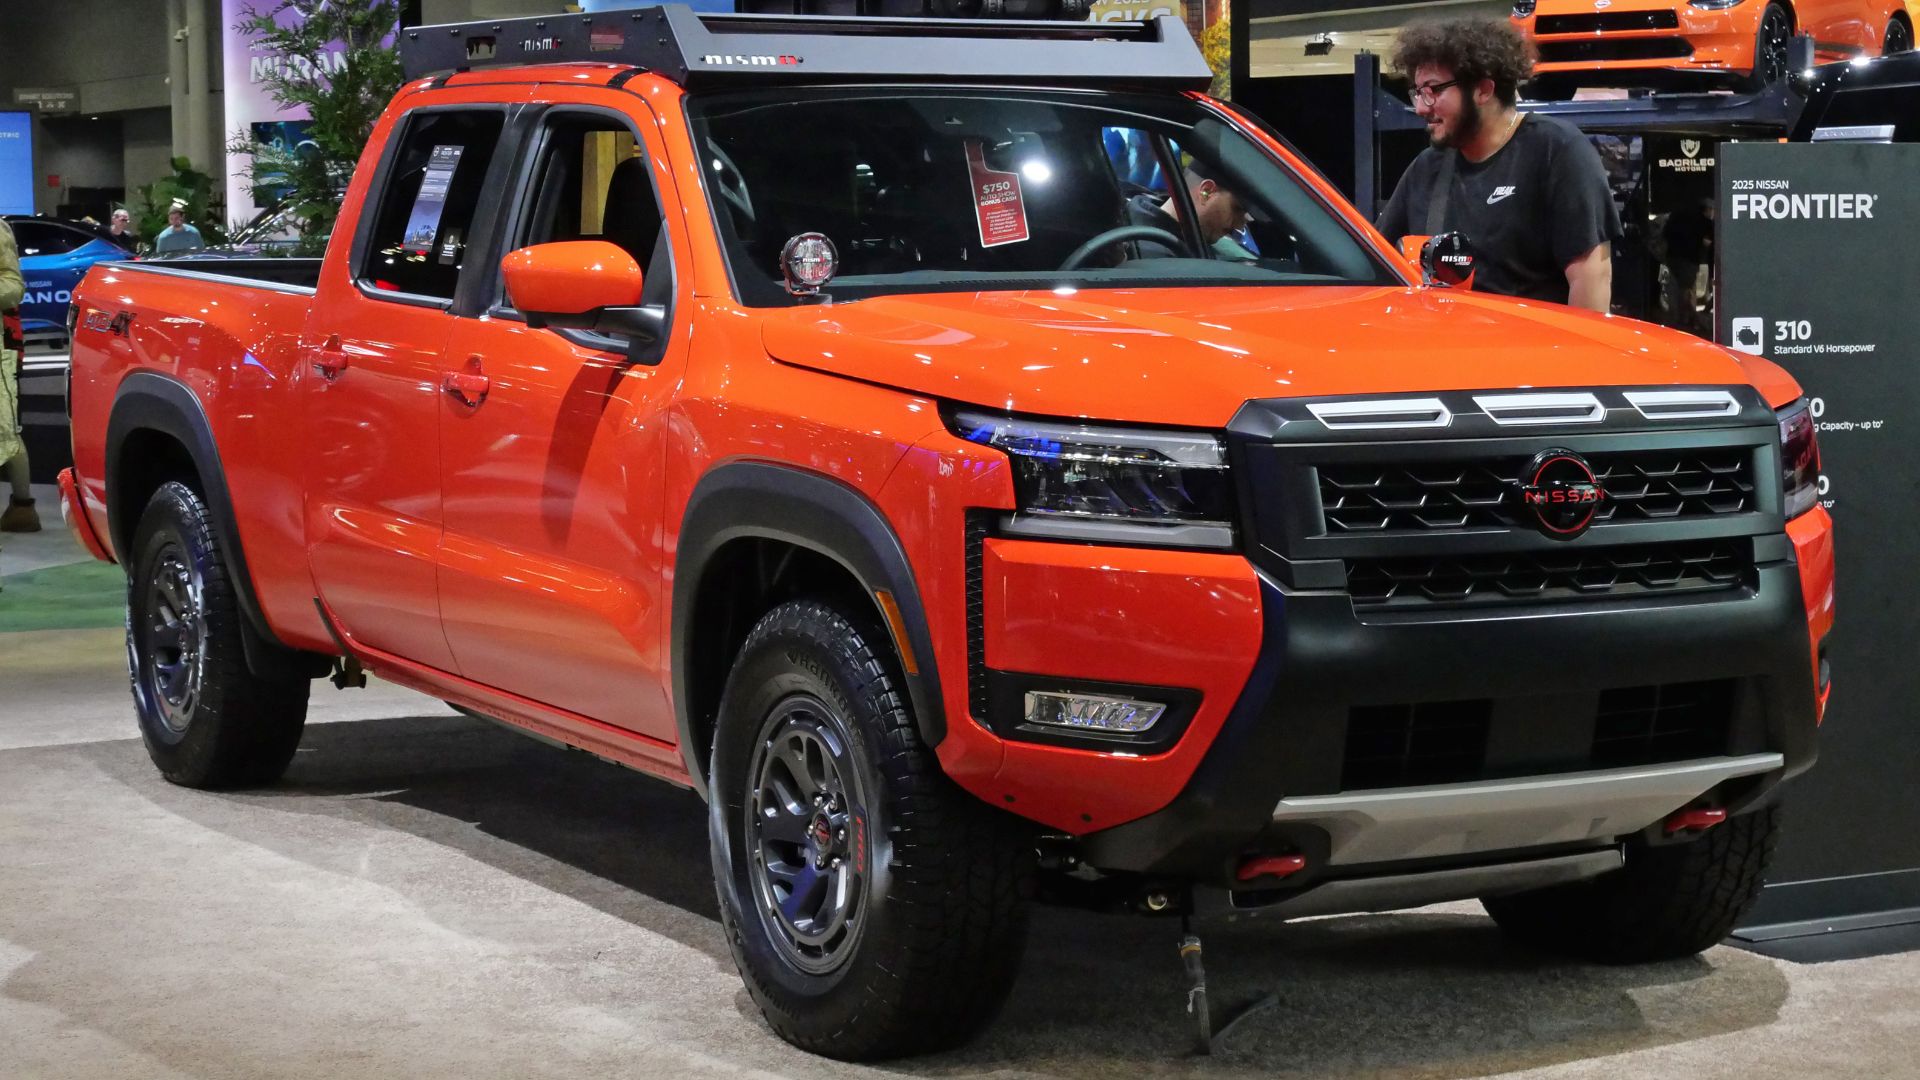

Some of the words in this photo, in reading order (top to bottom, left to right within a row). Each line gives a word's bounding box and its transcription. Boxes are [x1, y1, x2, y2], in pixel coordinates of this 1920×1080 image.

[982, 181, 1010, 194] $750
[1732, 180, 1754, 190] 2025
[1755, 180, 1789, 190] NISSAN
[19, 290, 71, 304] ANO
[1775, 320, 1812, 341] 310
[1774, 345, 1813, 355] Standard
[1813, 344, 1825, 353] V6
[1826, 344, 1875, 354] Horsepower
[1820, 421, 1854, 431] Capacity
[1860, 422, 1872, 430] up
[1525, 488, 1605, 504] NISSAN
